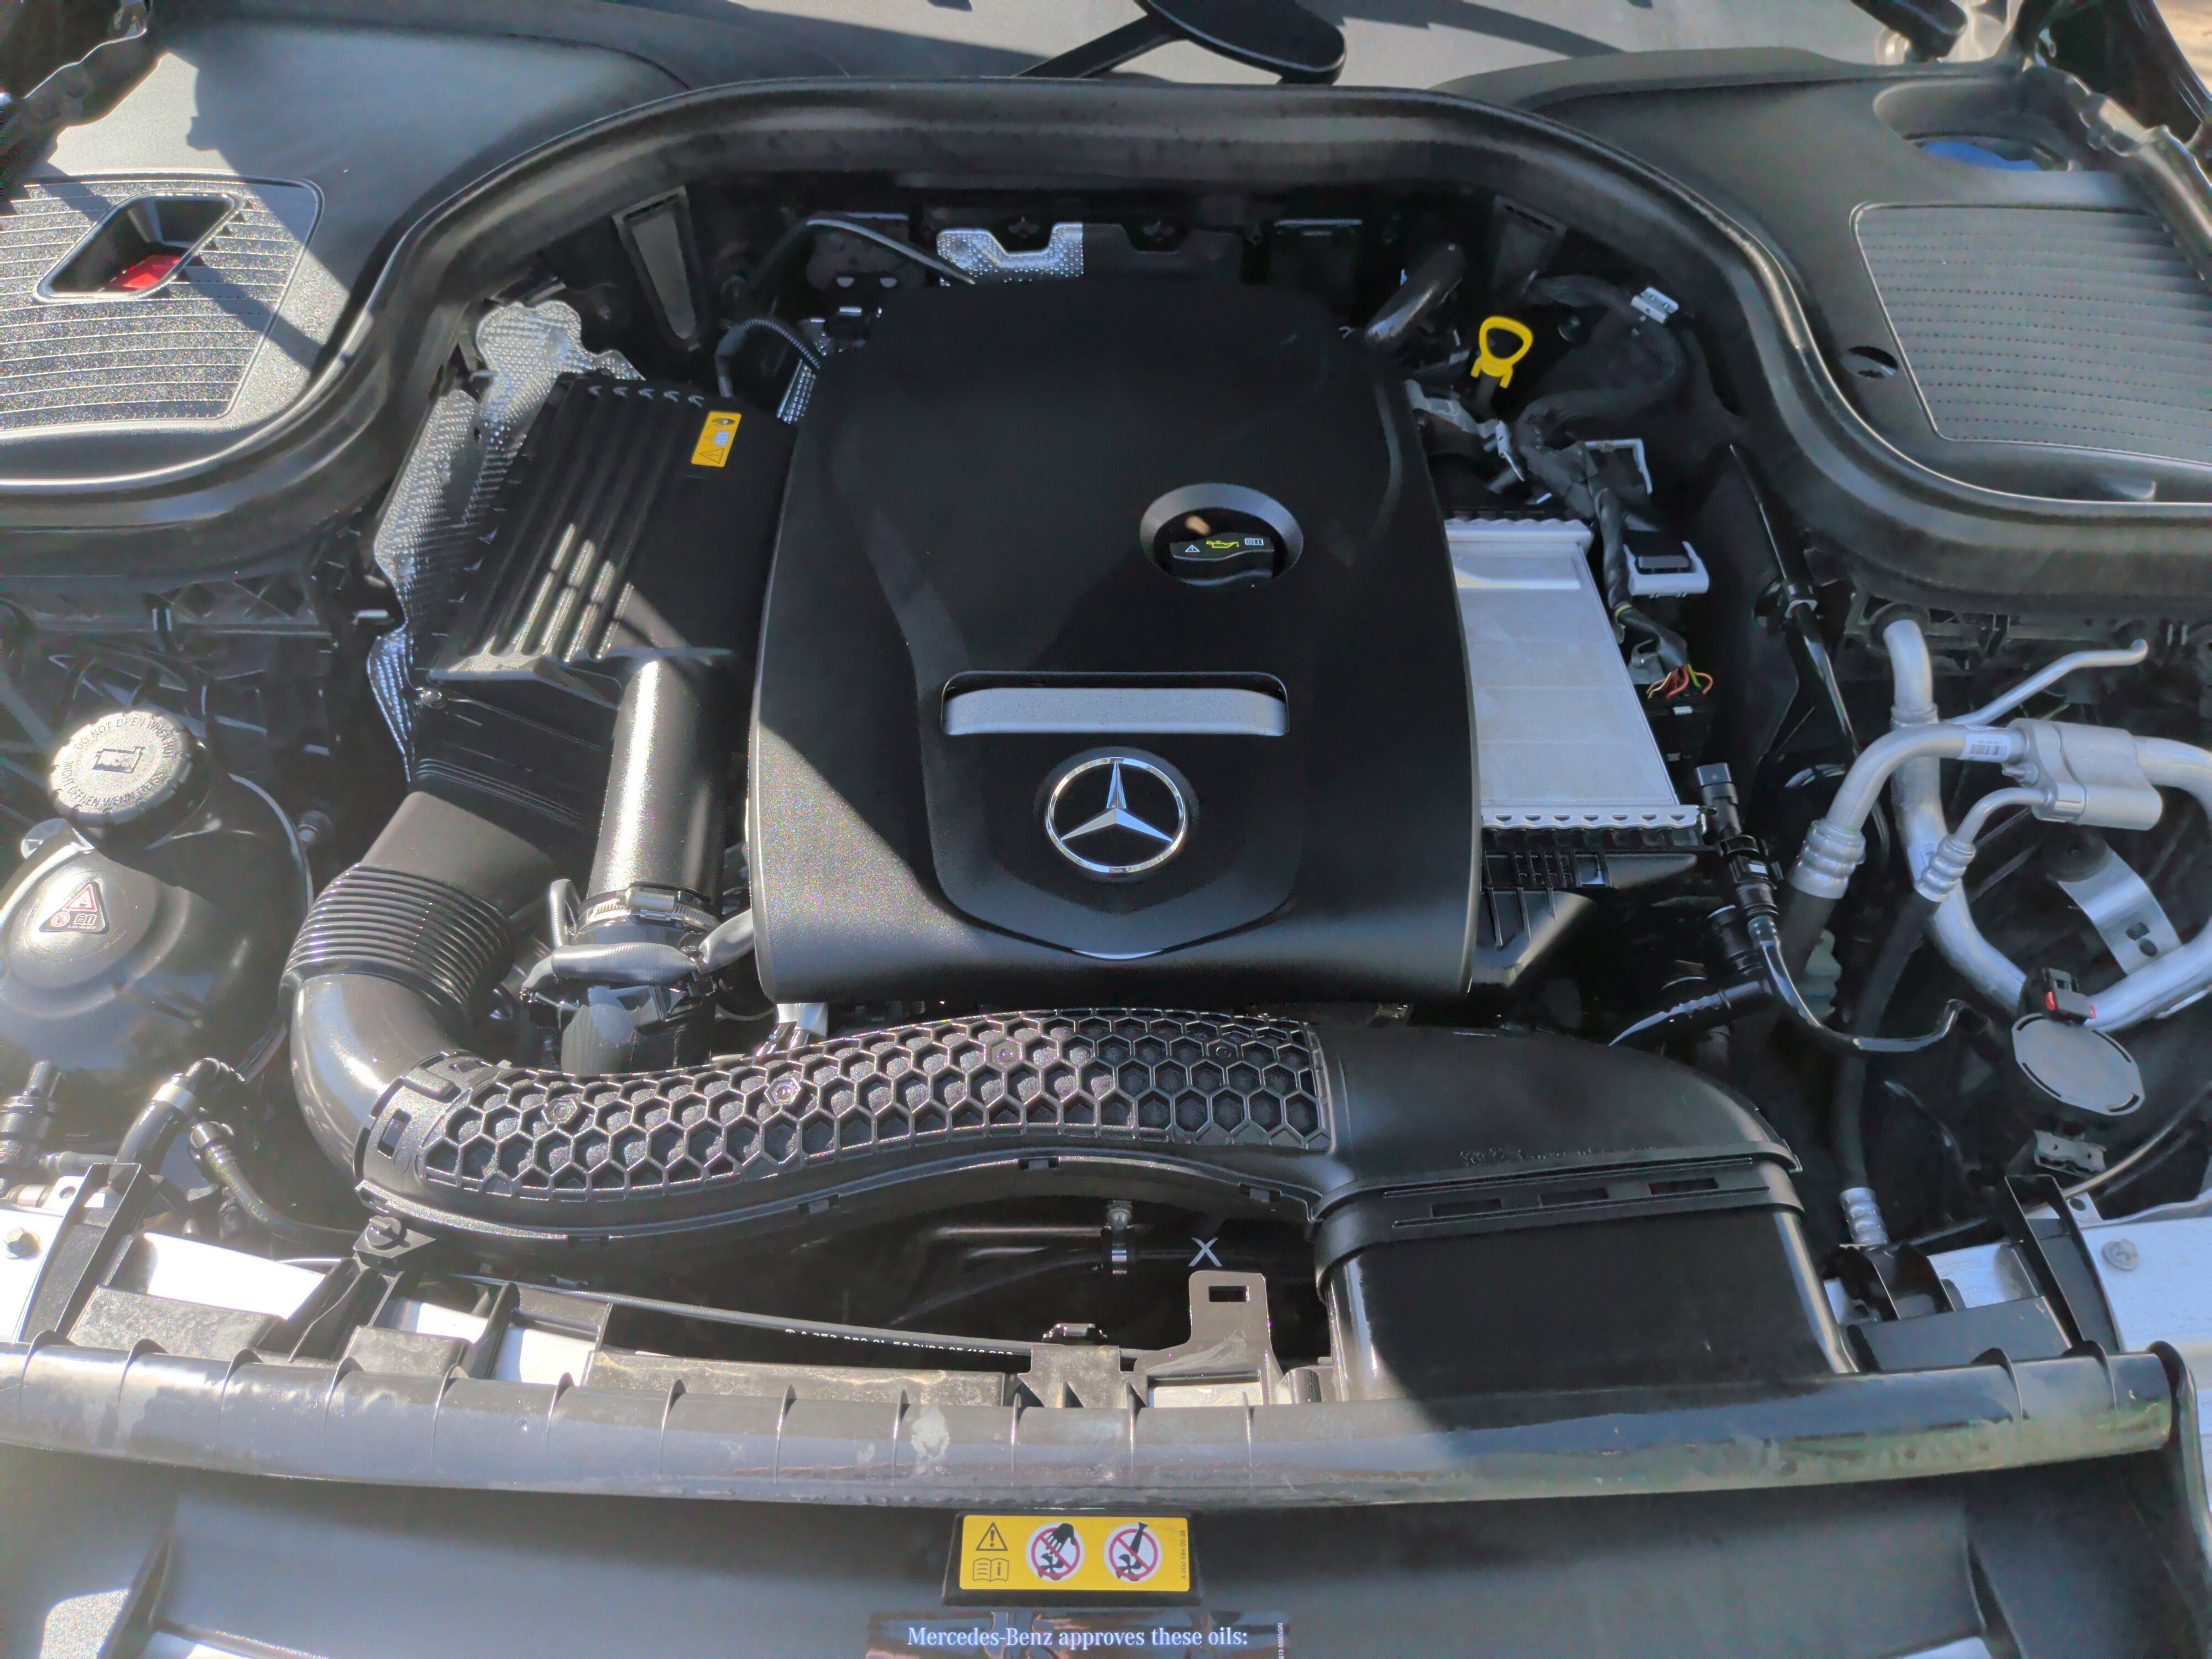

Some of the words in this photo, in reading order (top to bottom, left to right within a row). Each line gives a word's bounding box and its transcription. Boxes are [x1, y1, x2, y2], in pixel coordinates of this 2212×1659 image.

[74, 737, 90, 750] DO
[92, 722, 112, 737] NOT
[116, 718, 145, 727] OPEN
[146, 720, 170, 744] WHEN
[103, 792, 135, 807] WENN
[907, 1627, 1052, 1646] Mercedes-Benz
[1058, 1630, 1145, 1651] approves
[1151, 1627, 1203, 1646] these
[1208, 1627, 1248, 1646] oils:
